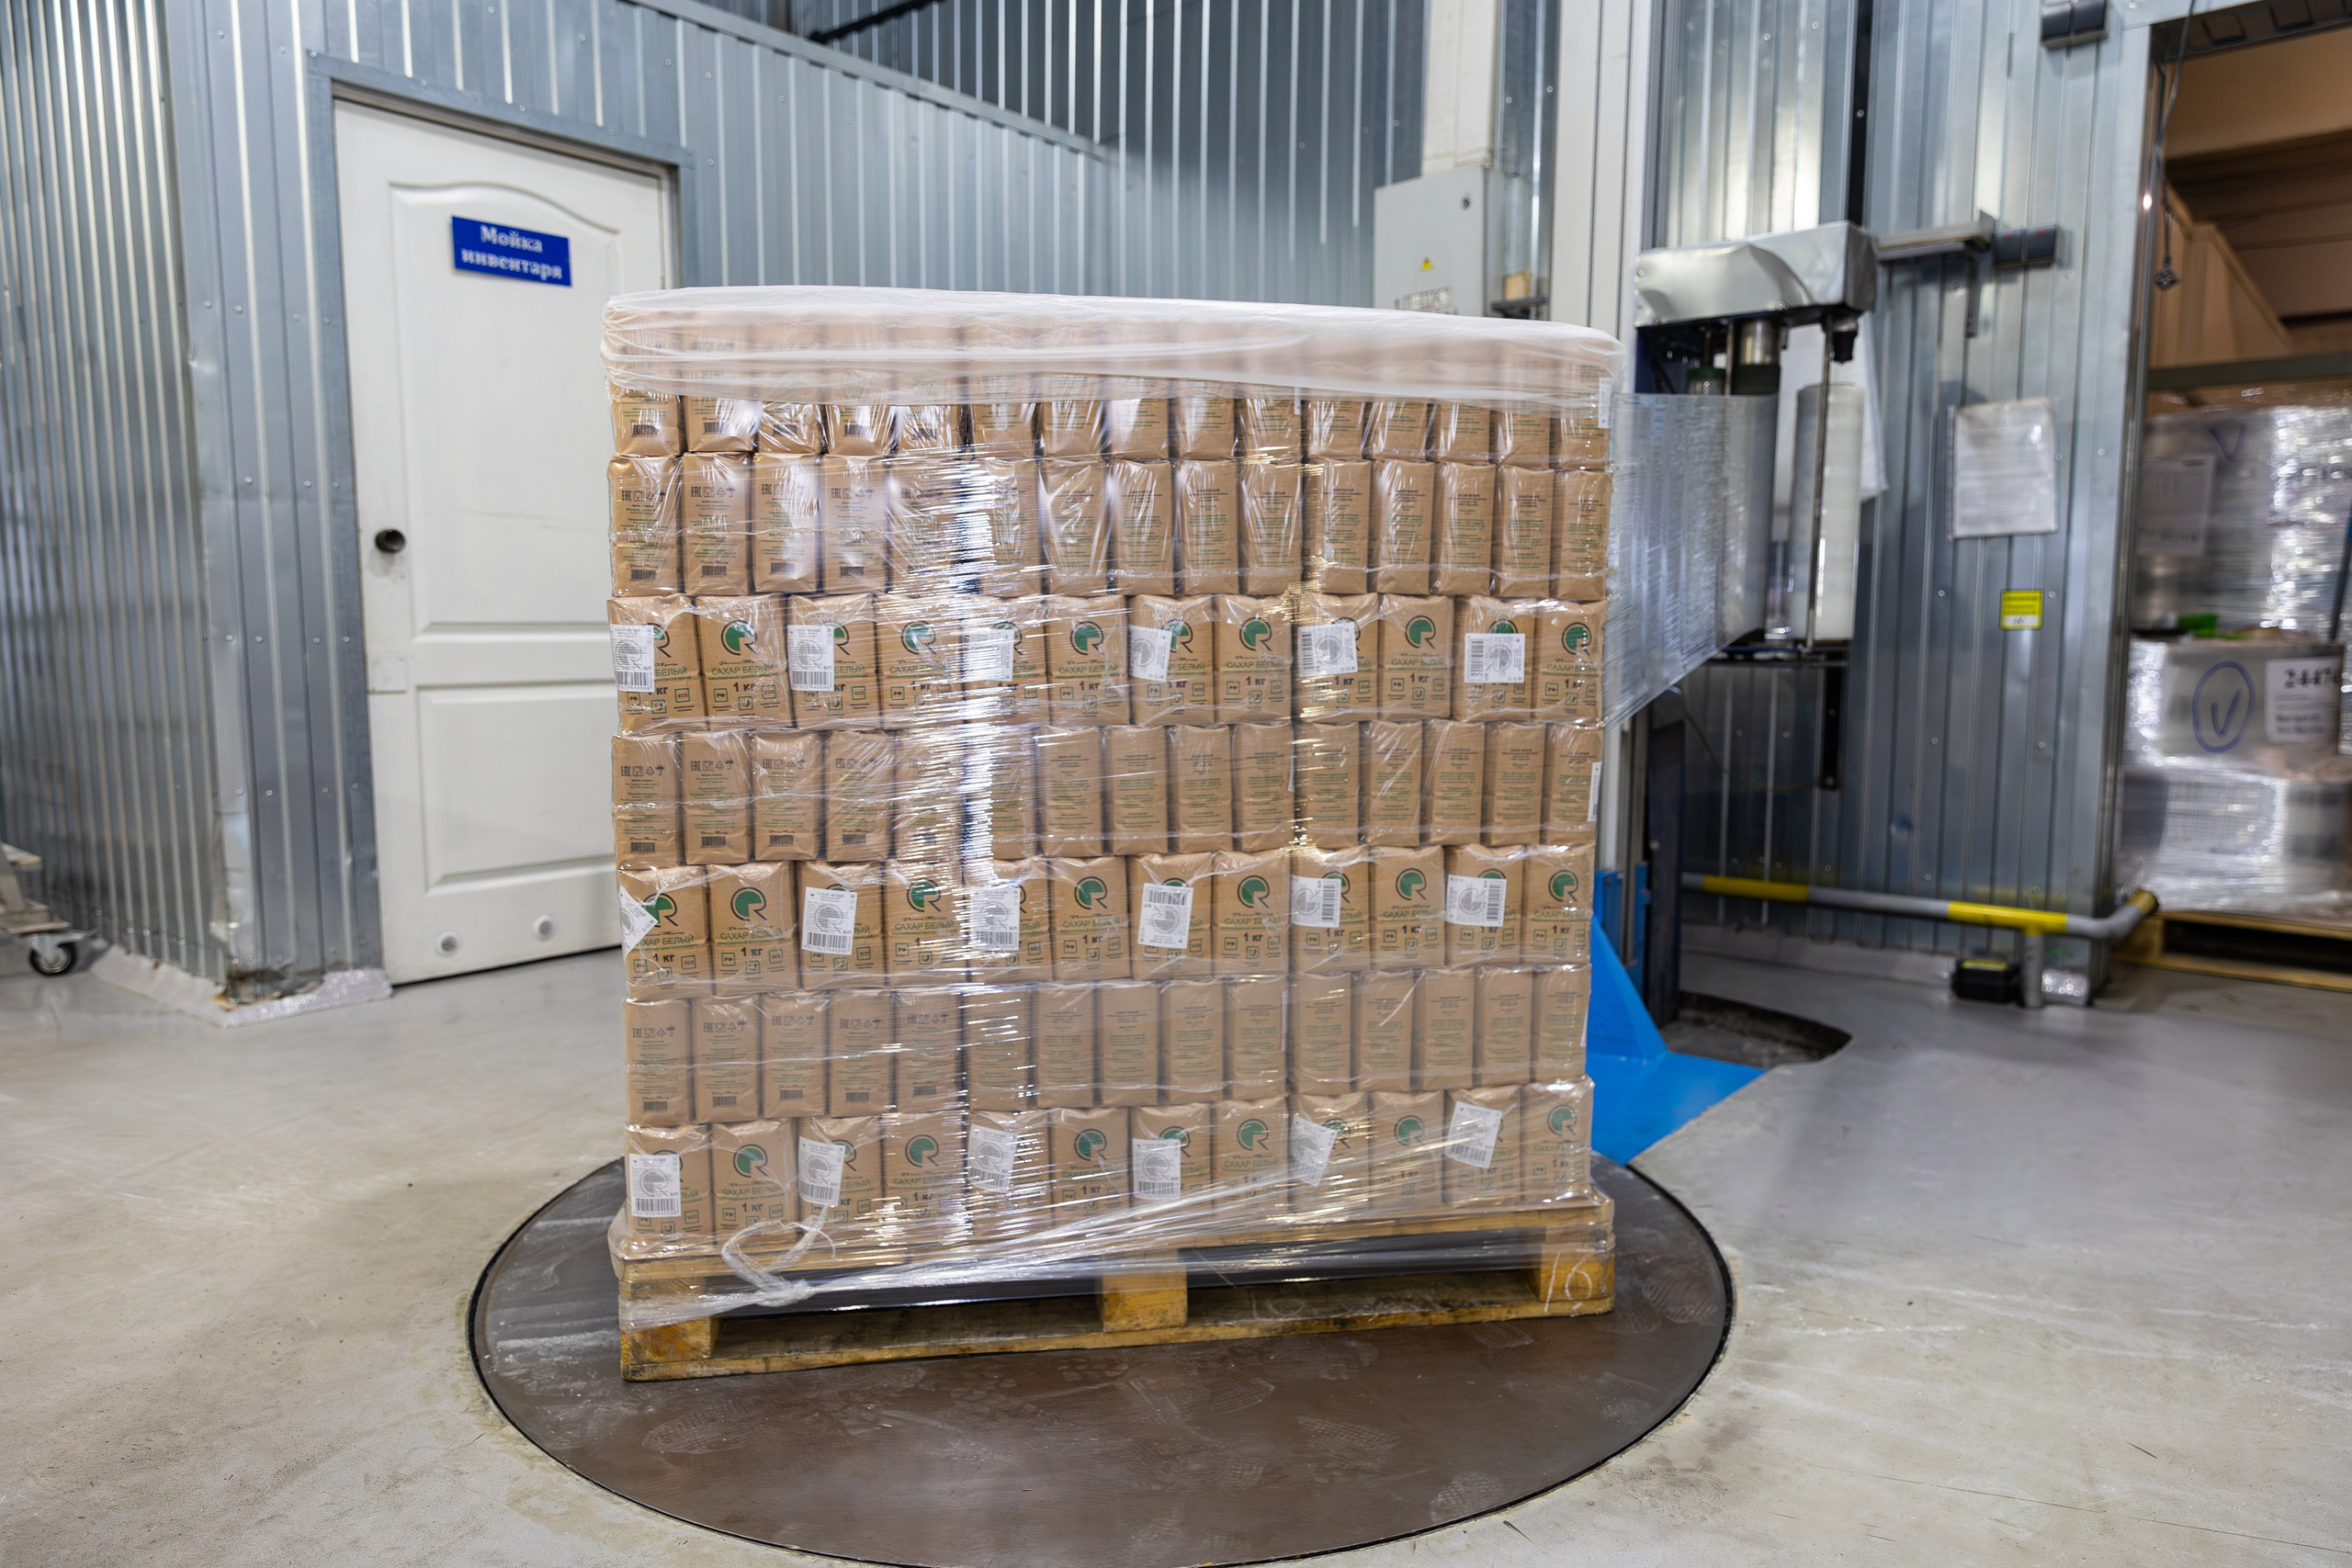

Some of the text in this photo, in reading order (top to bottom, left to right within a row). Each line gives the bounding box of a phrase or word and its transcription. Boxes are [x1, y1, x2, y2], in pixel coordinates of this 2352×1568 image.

[480, 225, 543, 253] Мойка
[461, 249, 562, 281] инвентаря
[655, 667, 687, 676] БЕЛЫЙ
[711, 665, 774, 675] САХАР БЕЛЫЙ
[1246, 676, 1250, 685] 1
[1335, 676, 1340, 684] 1
[1565, 679, 1568, 688] 1
[733, 682, 739, 692] 1
[1080, 682, 1084, 690] 1
[895, 921, 954, 931] САХАР БЕЛЫЙ
[1402, 925, 1407, 933] 1
[1553, 925, 1556, 933] 1
[662, 935, 694, 944] БЕЛЫЙ
[1083, 935, 1088, 943] 1
[1243, 933, 1248, 942] 1
[741, 947, 763, 956] 1 кг
[1081, 1186, 1086, 1194] 1
[741, 1203, 747, 1212] 1
